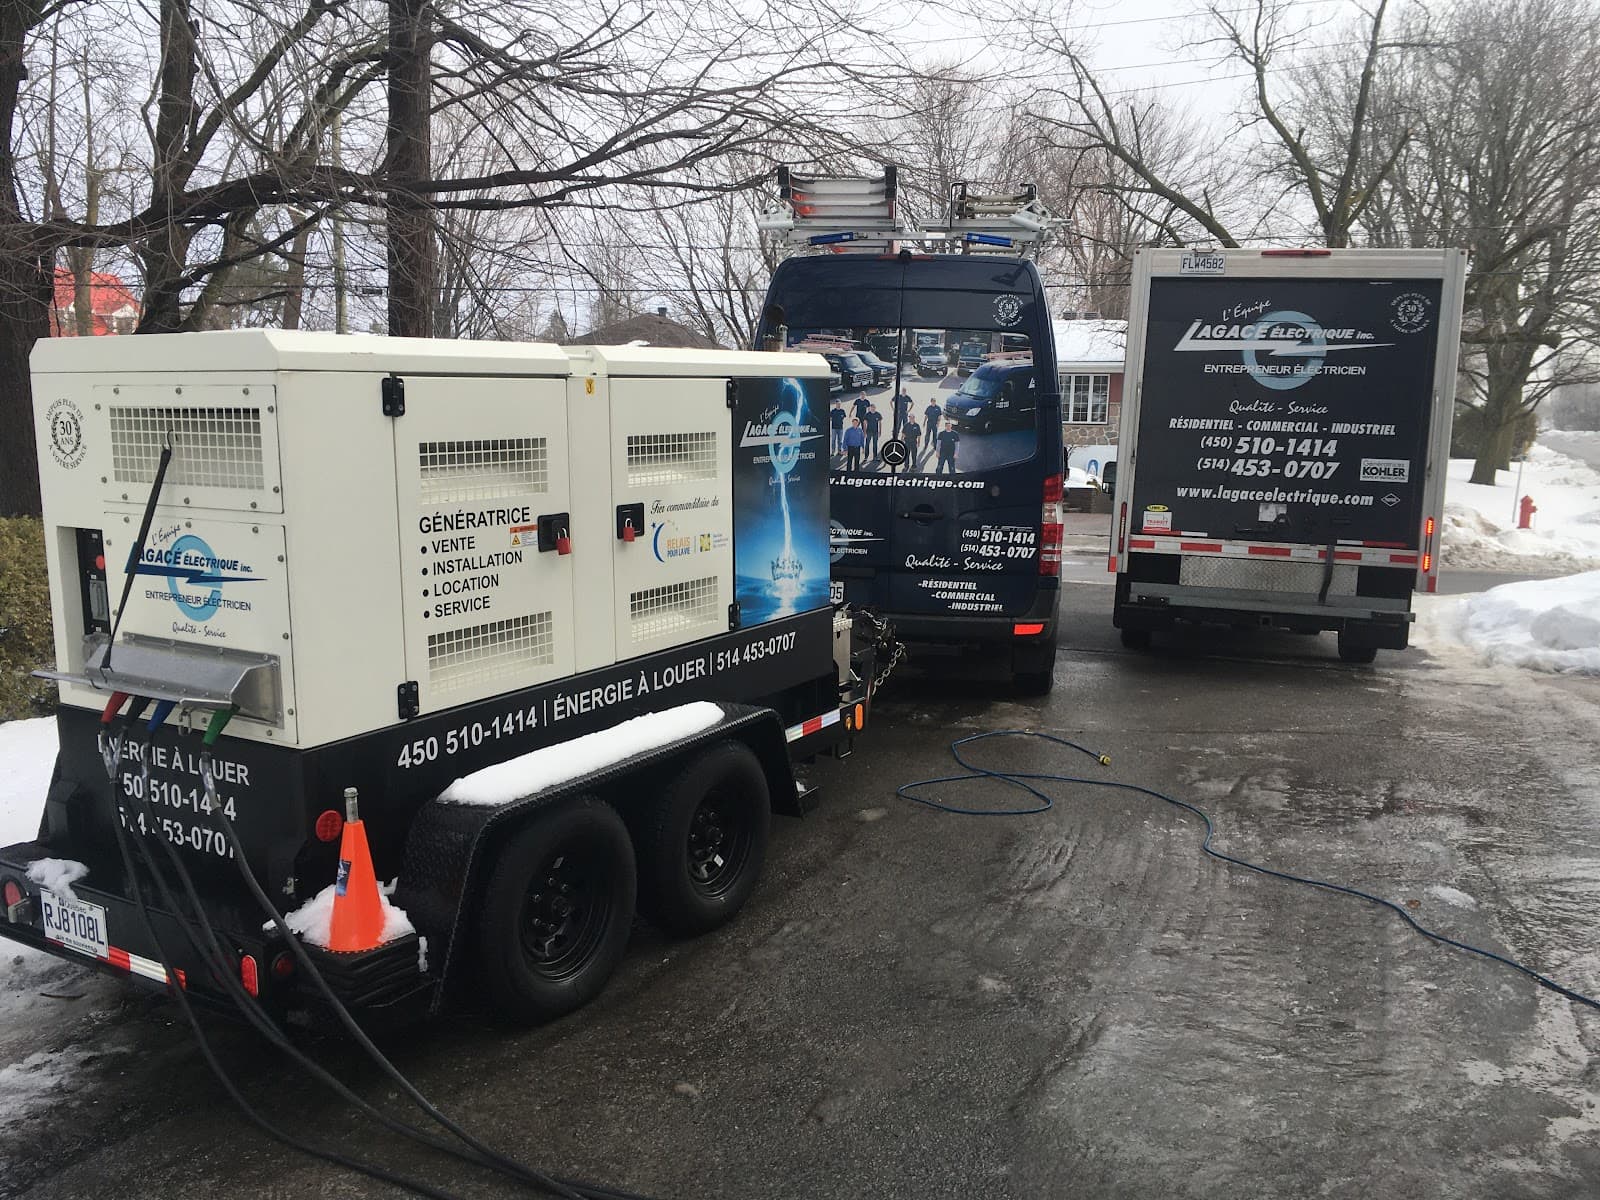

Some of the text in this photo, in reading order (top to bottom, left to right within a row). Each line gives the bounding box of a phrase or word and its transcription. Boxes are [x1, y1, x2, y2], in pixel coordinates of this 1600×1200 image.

[1182, 258, 1224, 270] FLW4582
[1270, 326, 1353, 340] ÉLECTRIQUE
[1356, 330, 1375, 340] inc.
[1204, 363, 1366, 376] ENTREPRENEUR ÉLECTRICIEN
[1229, 400, 1275, 414] Qualité
[1288, 400, 1328, 414] Service
[60, 420, 72, 436] 30
[1169, 416, 1234, 430] RÉSIDENTIEL
[1246, 420, 1318, 434] COMMERCIAL
[1331, 423, 1396, 436] INDUSTRIEL
[60, 436, 74, 446] ANS
[1200, 436, 1338, 458] (450) 510-1414
[70, 444, 87, 470] SERVICE
[1197, 458, 1341, 480] (514) 453-0707
[1362, 466, 1405, 476] KOHLER
[1176, 484, 1374, 506] www.lagaceelectrique.com
[419, 506, 531, 534] GÉNÉRATRICE
[432, 536, 476, 554] VENTE
[666, 536, 690, 549] RELAIS
[962, 529, 1036, 545] (450) 510-1414
[184, 551, 239, 572] ÉLECTRIQUE
[240, 563, 253, 573] inc.
[667, 550, 678, 558] POUR
[960, 544, 1037, 559] (514) 453-0707
[433, 550, 522, 576] INSTALLATION
[905, 554, 951, 568] Qualité
[964, 557, 1004, 571] Service
[434, 574, 500, 597] LOCATION
[145, 590, 252, 612] ENTREPRENEUR ÉLECTRICIEN
[434, 596, 491, 618] SERVICE
[172, 622, 196, 635] Qualité
[204, 626, 227, 638] Service
[397, 735, 439, 770] 450
[445, 706, 538, 755] 510-1414
[553, 676, 634, 722] ÉNERGIE
[638, 671, 650, 695] À
[654, 658, 706, 691] LOUER
[716, 648, 740, 672] 514
[742, 632, 796, 663] 453-0707
[172, 746, 184, 772] À
[118, 772, 236, 822] 50 510-144
[152, 816, 234, 858] 53-070
[44, 902, 104, 946] RJ8108L
